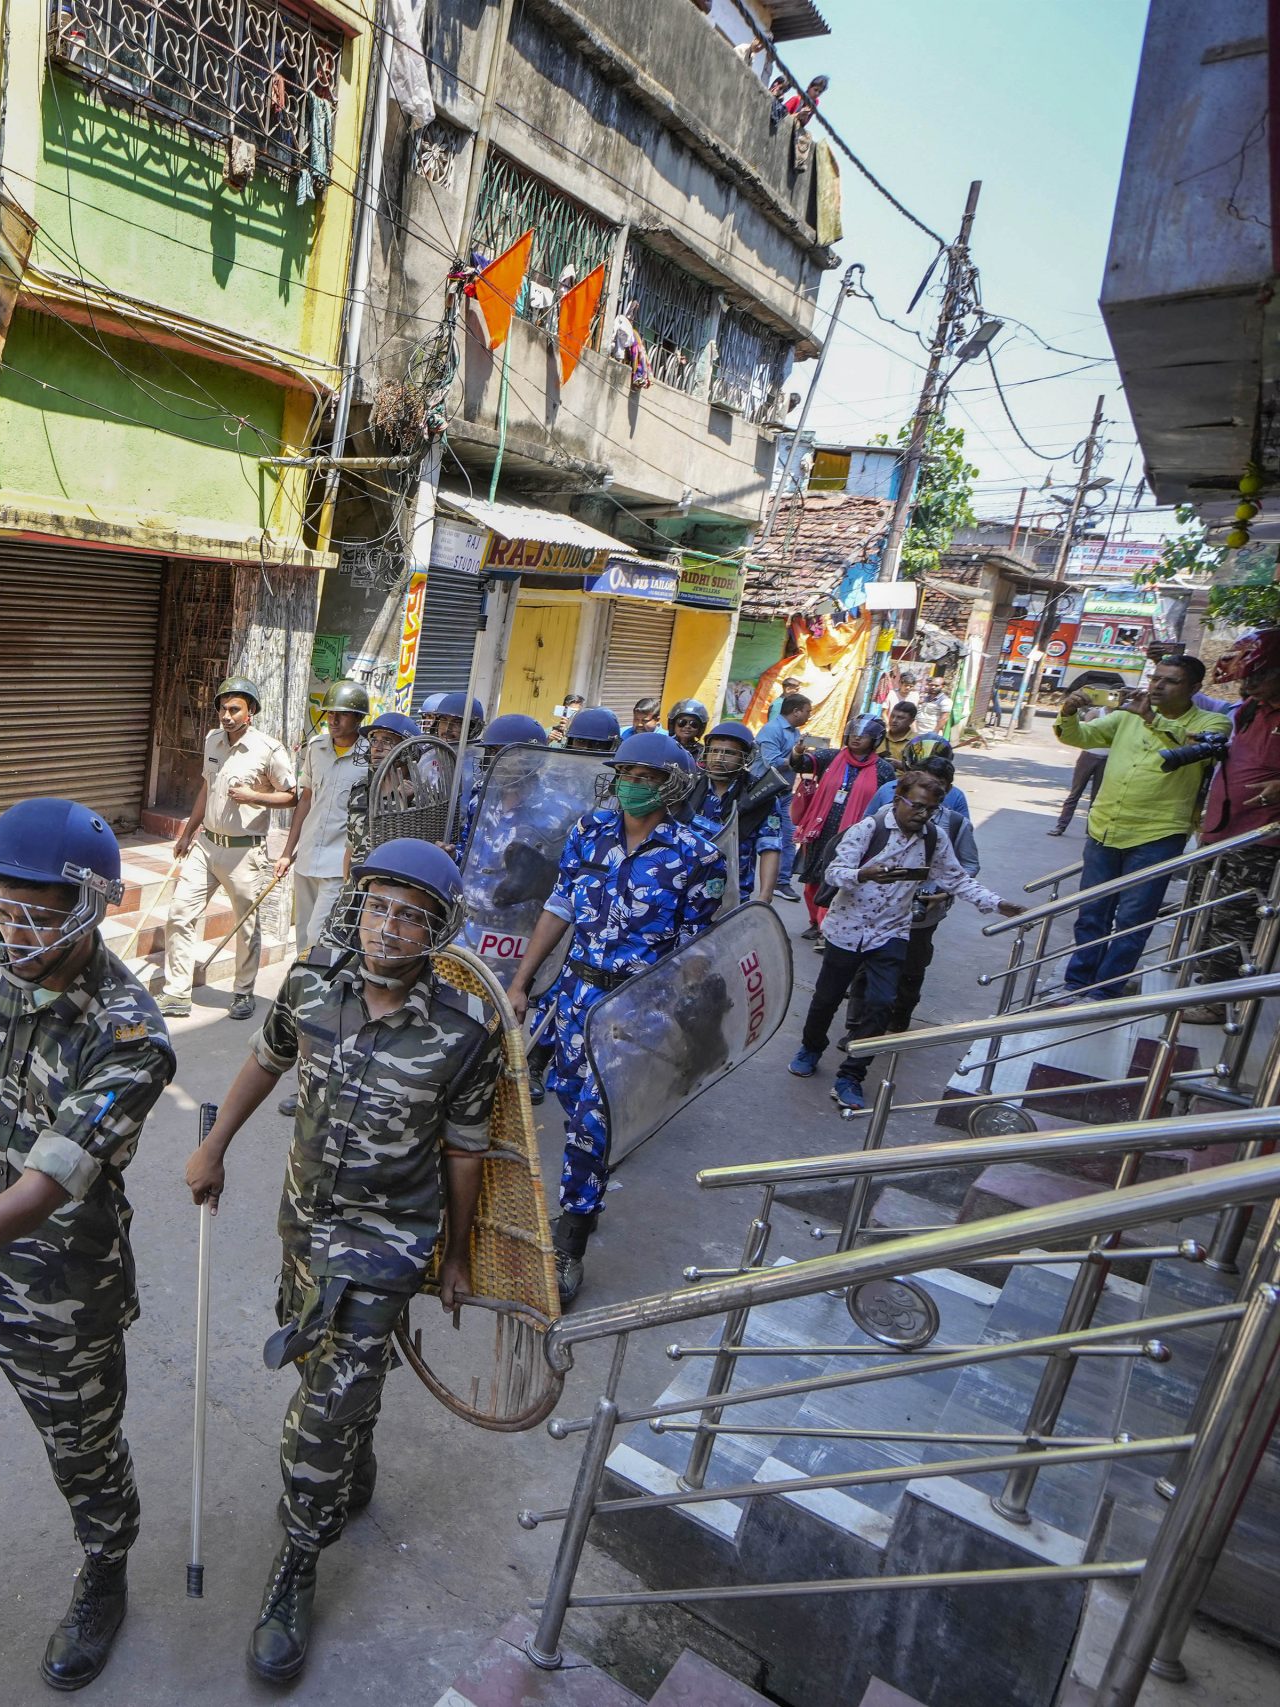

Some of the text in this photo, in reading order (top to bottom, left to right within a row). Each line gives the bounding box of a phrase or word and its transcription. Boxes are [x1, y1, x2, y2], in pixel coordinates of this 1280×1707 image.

[490, 533, 545, 567] RAJ
[680, 570, 711, 587] RIDHI
[741, 952, 765, 1050] POLICE
